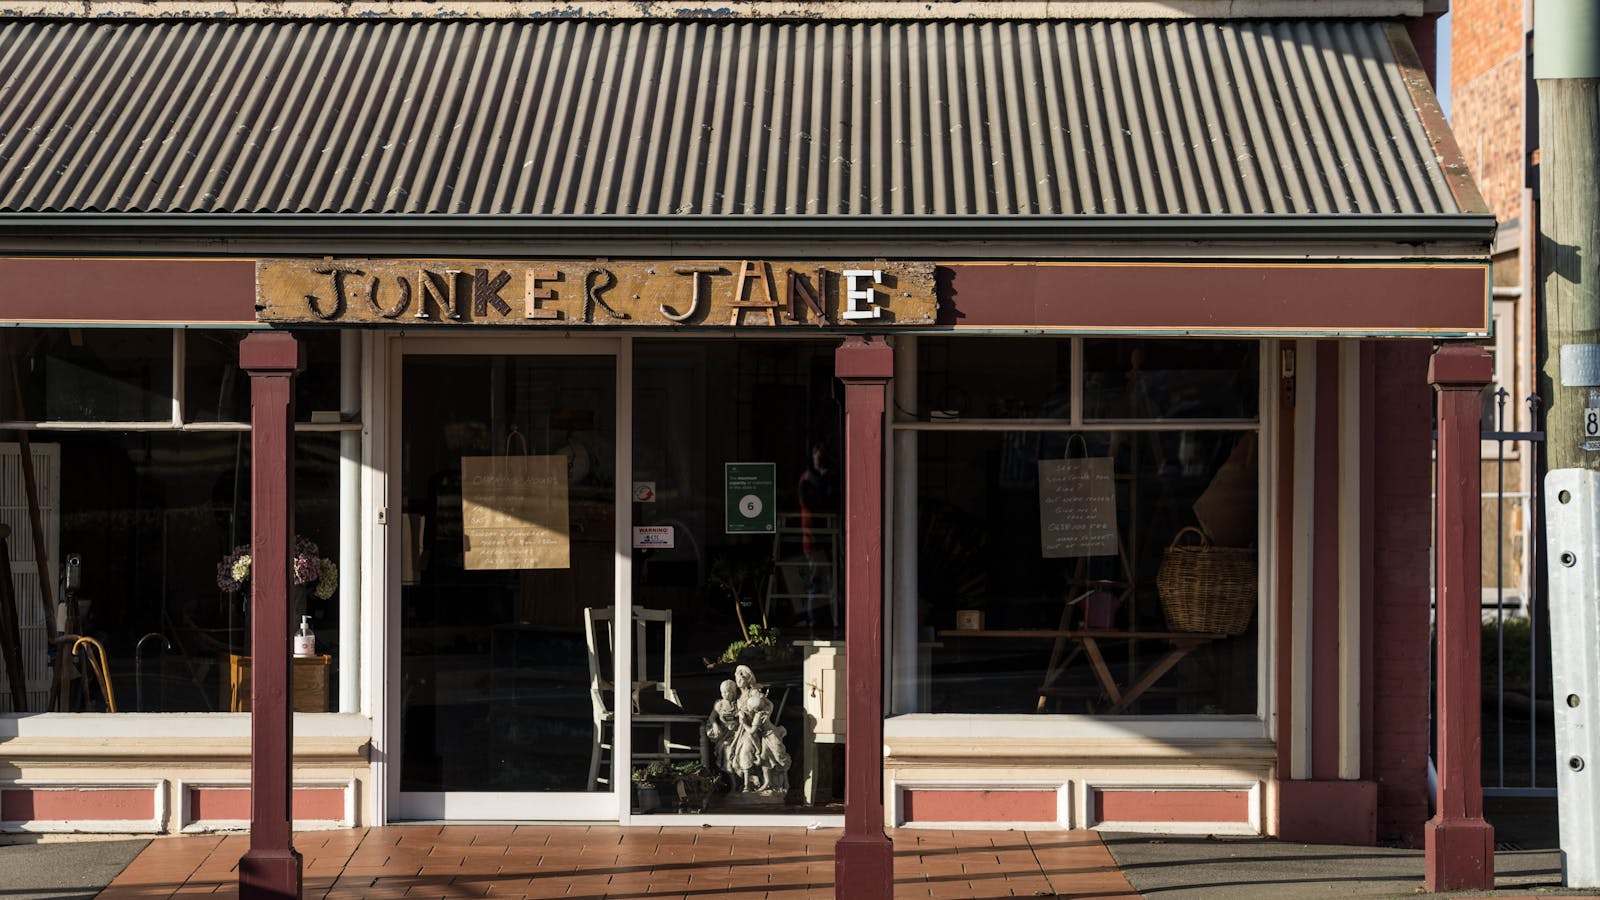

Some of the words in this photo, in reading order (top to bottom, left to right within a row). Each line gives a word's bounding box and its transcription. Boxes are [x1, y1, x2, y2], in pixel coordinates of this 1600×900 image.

[304, 265, 631, 323] JUNKER
[660, 260, 881, 327] JANE
[1587, 412, 1598, 435] 8
[747, 502, 754, 511] 6
